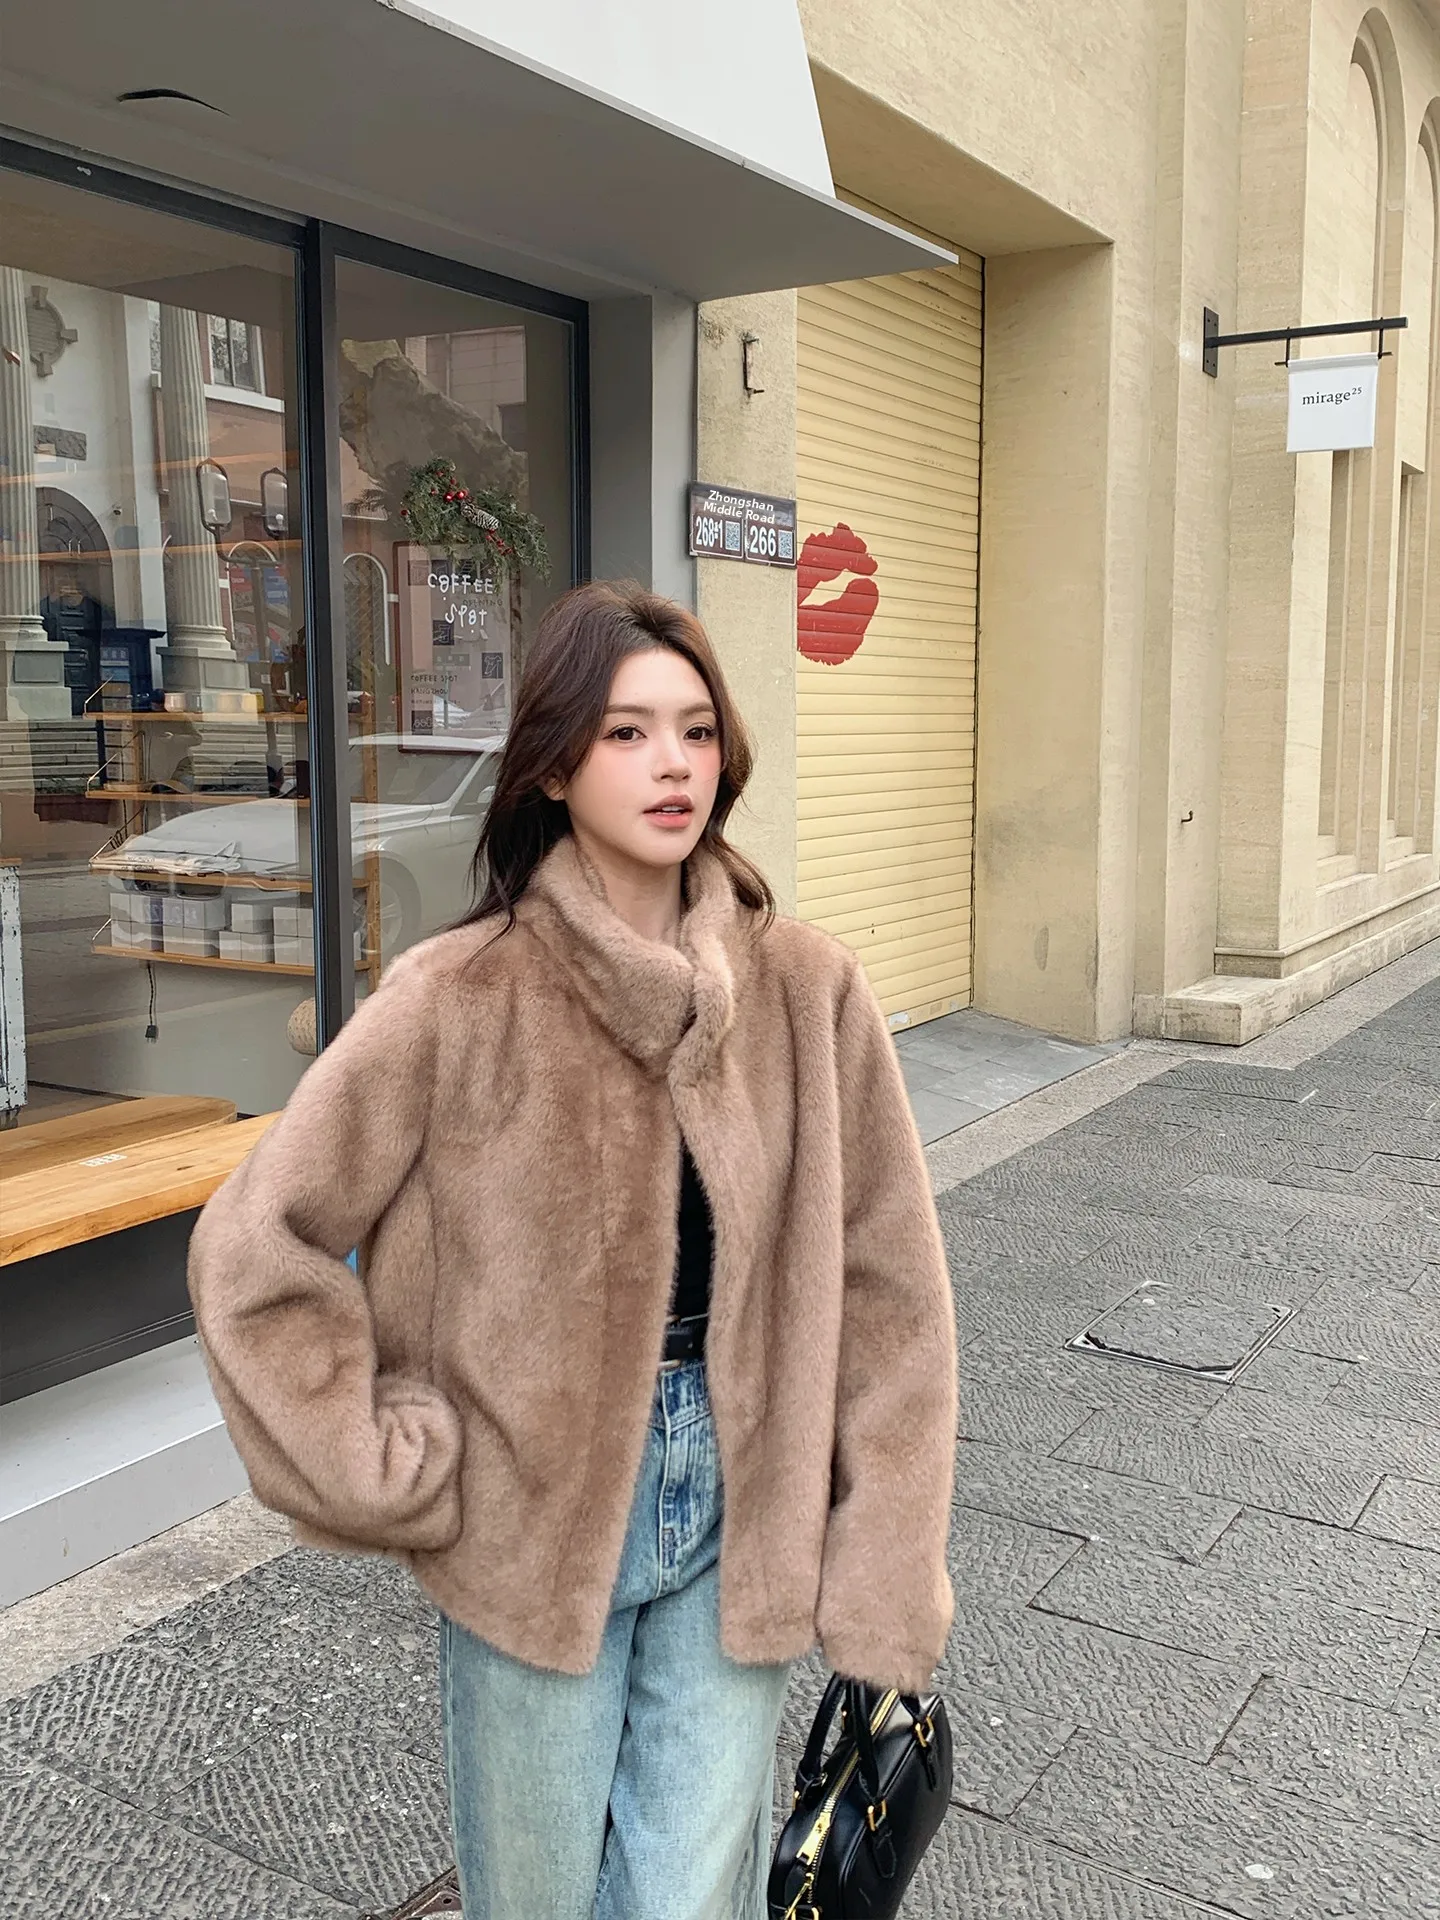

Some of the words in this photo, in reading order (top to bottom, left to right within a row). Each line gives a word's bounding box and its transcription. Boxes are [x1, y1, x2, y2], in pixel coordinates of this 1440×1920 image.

[708, 489, 774, 512] Zhongshan
[703, 501, 743, 518] Middle
[745, 509, 775, 525] Road
[749, 525, 777, 556] 266
[427, 573, 494, 595] COFFEE
[410, 674, 437, 683] COFFEE
